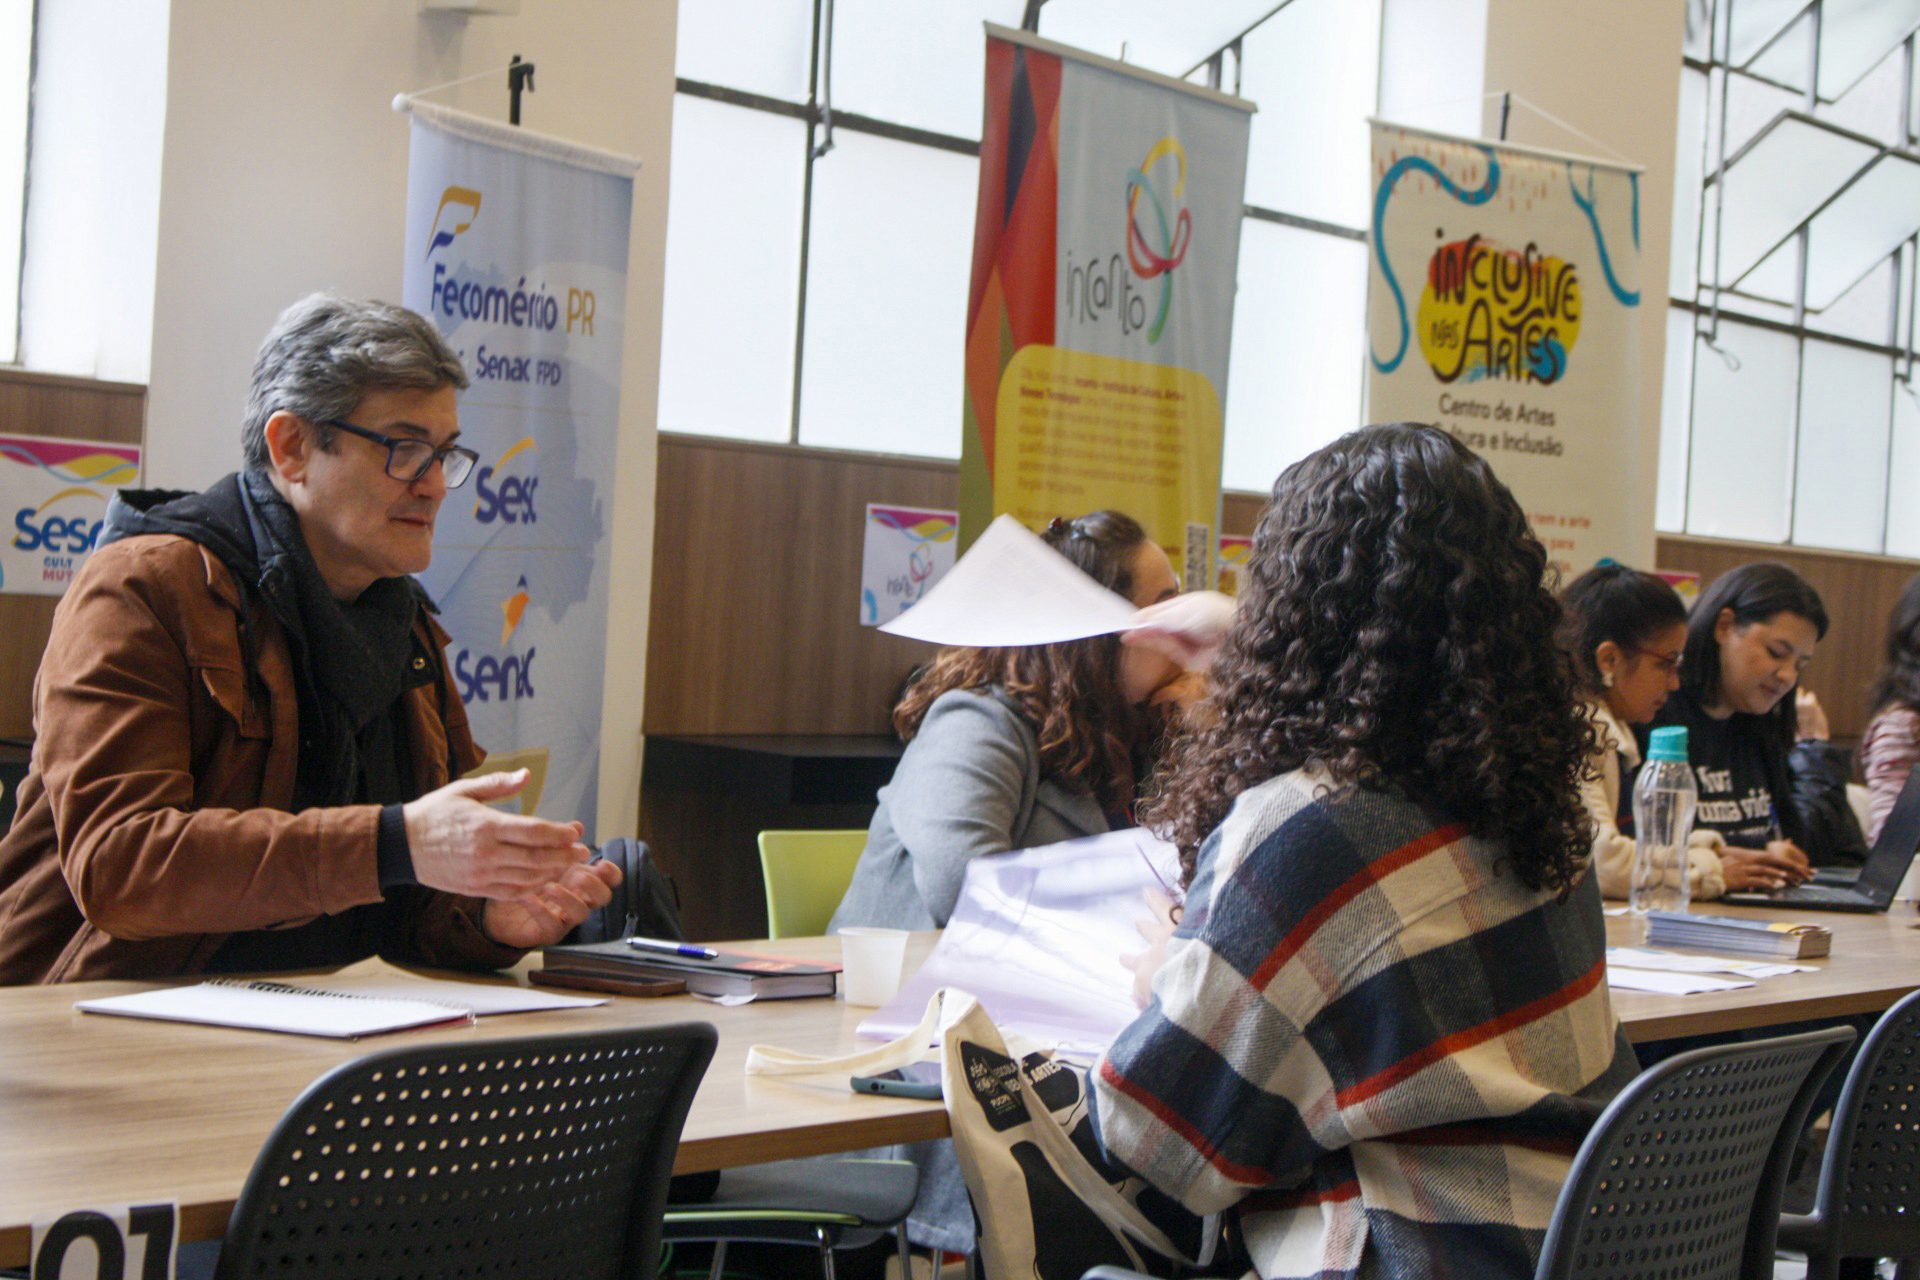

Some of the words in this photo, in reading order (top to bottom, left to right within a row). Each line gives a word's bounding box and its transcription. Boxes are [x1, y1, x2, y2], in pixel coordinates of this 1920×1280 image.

[566, 288, 596, 336] PR
[476, 344, 531, 382] Senac
[1438, 392, 1490, 419] Centro
[1494, 399, 1512, 422] de
[1516, 403, 1556, 427] Artes
[36, 1203, 175, 1280] 01
